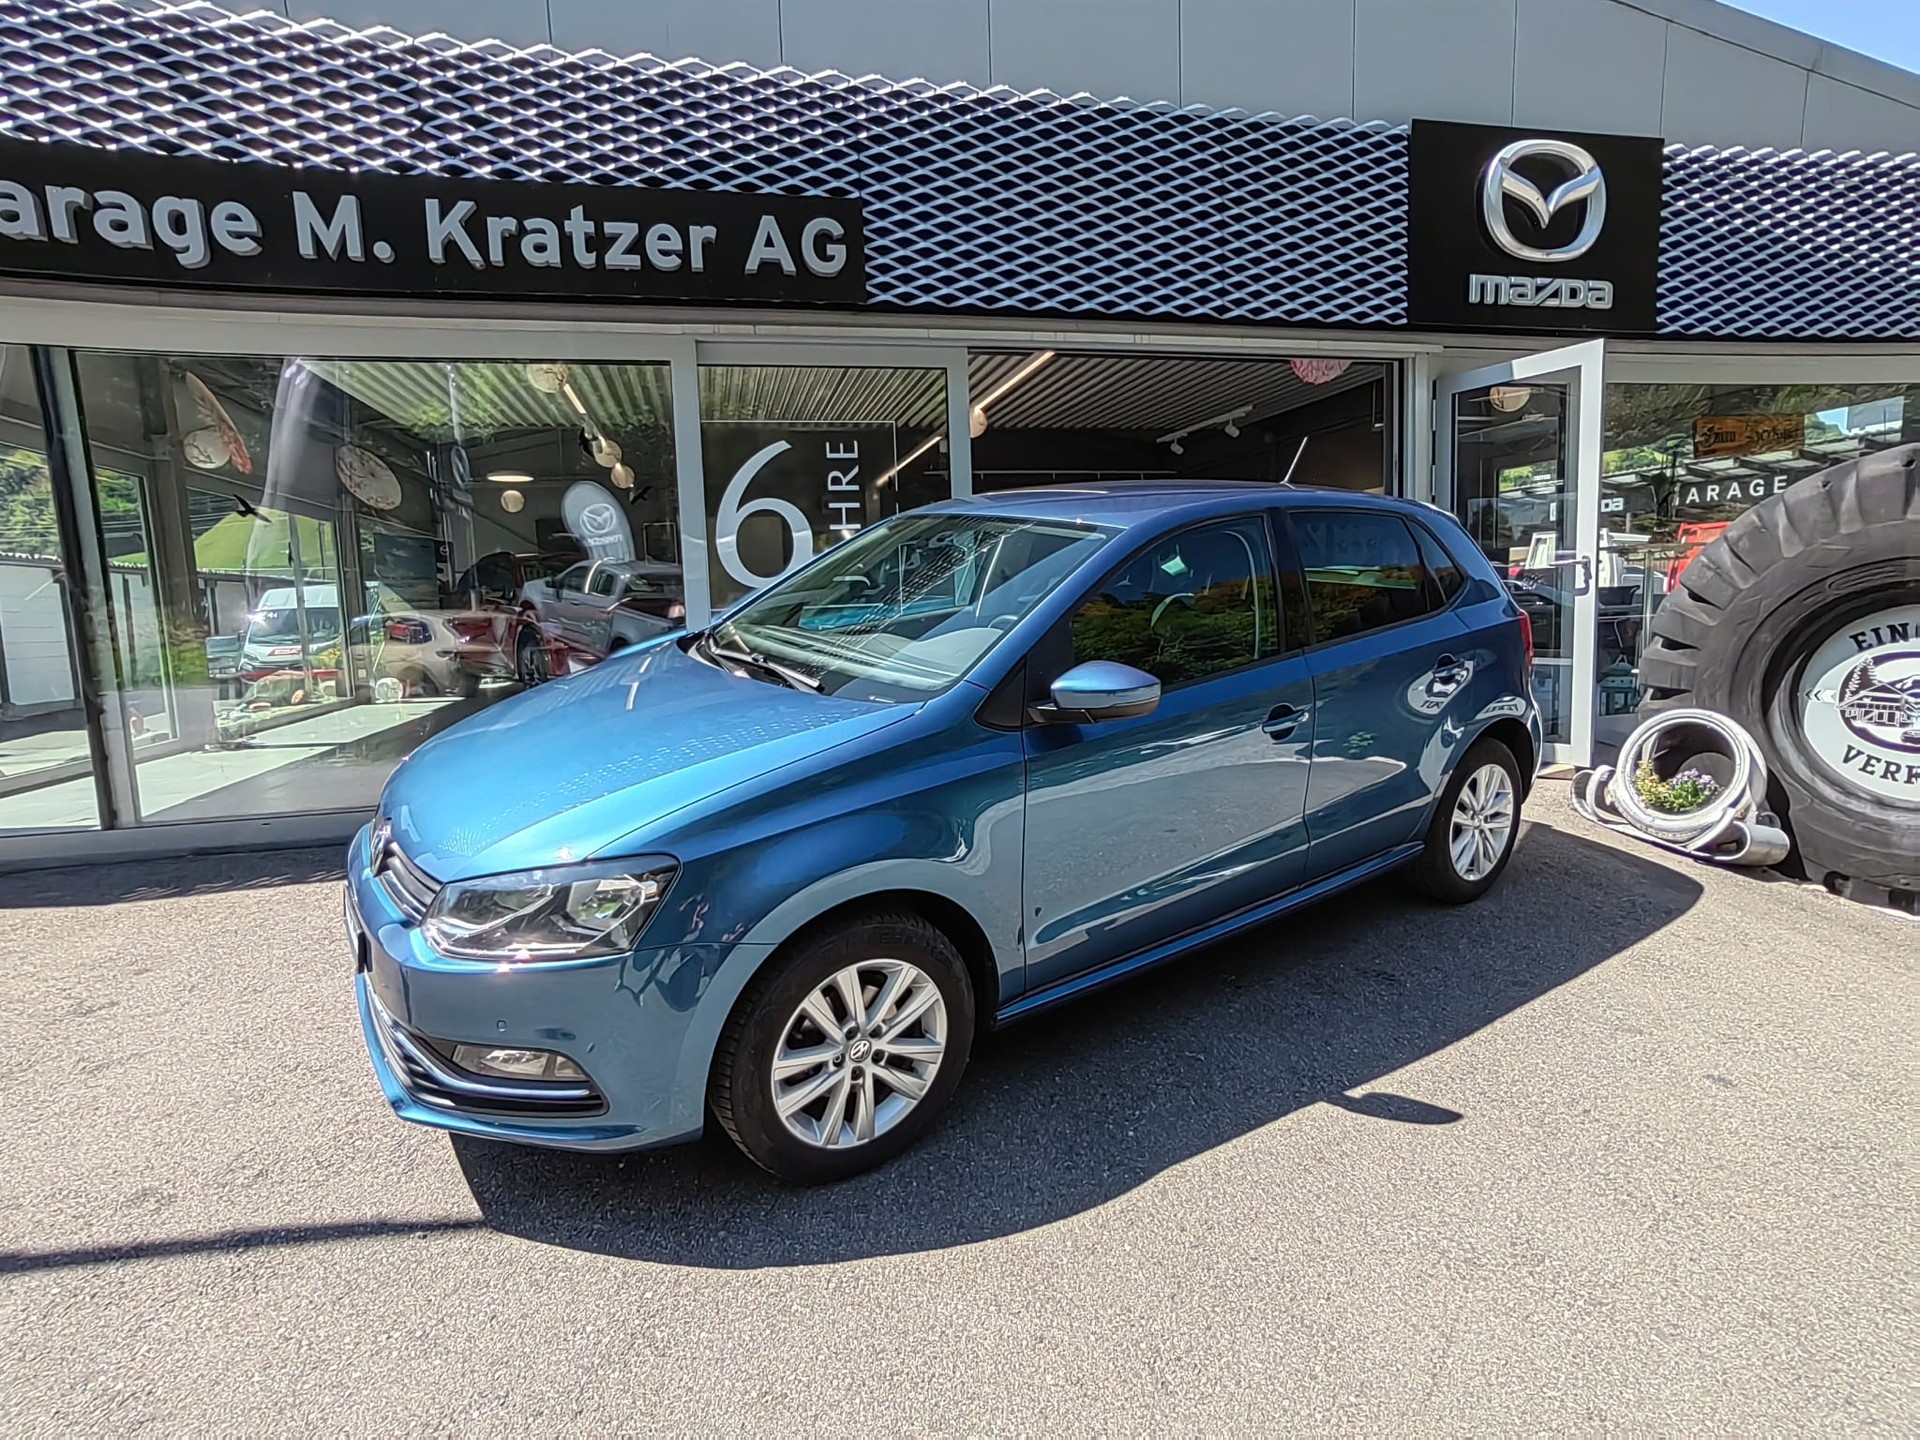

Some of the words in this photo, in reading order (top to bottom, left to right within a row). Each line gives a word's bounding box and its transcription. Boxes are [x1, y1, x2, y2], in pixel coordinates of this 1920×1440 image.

[292, 191, 395, 263] M.
[424, 198, 717, 272] Kratzer
[744, 215, 847, 277] AG
[715, 440, 813, 589] 6
[1674, 475, 1788, 506] ARAGE
[1849, 622, 1920, 650] EIN
